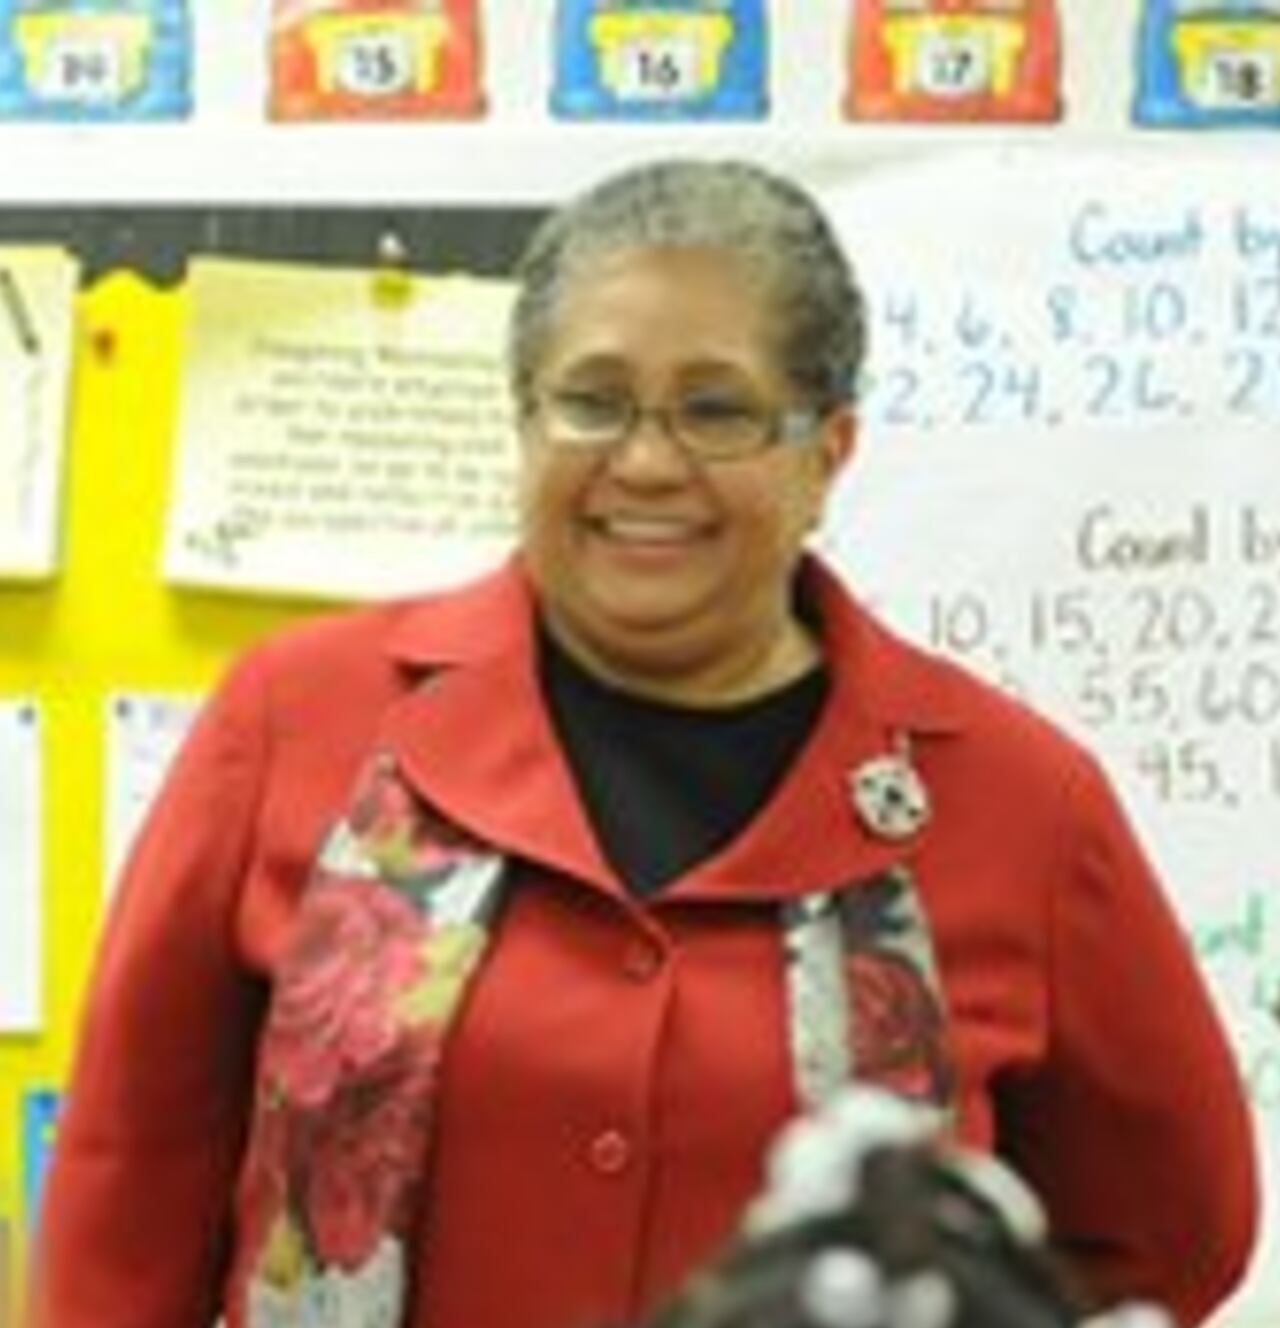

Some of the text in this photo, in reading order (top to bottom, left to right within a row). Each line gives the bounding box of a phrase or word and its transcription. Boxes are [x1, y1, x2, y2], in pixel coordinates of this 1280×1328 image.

[351, 48, 397, 83] 15
[635, 52, 681, 87] 16
[933, 53, 973, 87] 17
[1216, 60, 1261, 96] 18
[1069, 203, 1202, 266] Count
[1076, 504, 1209, 572] Count
